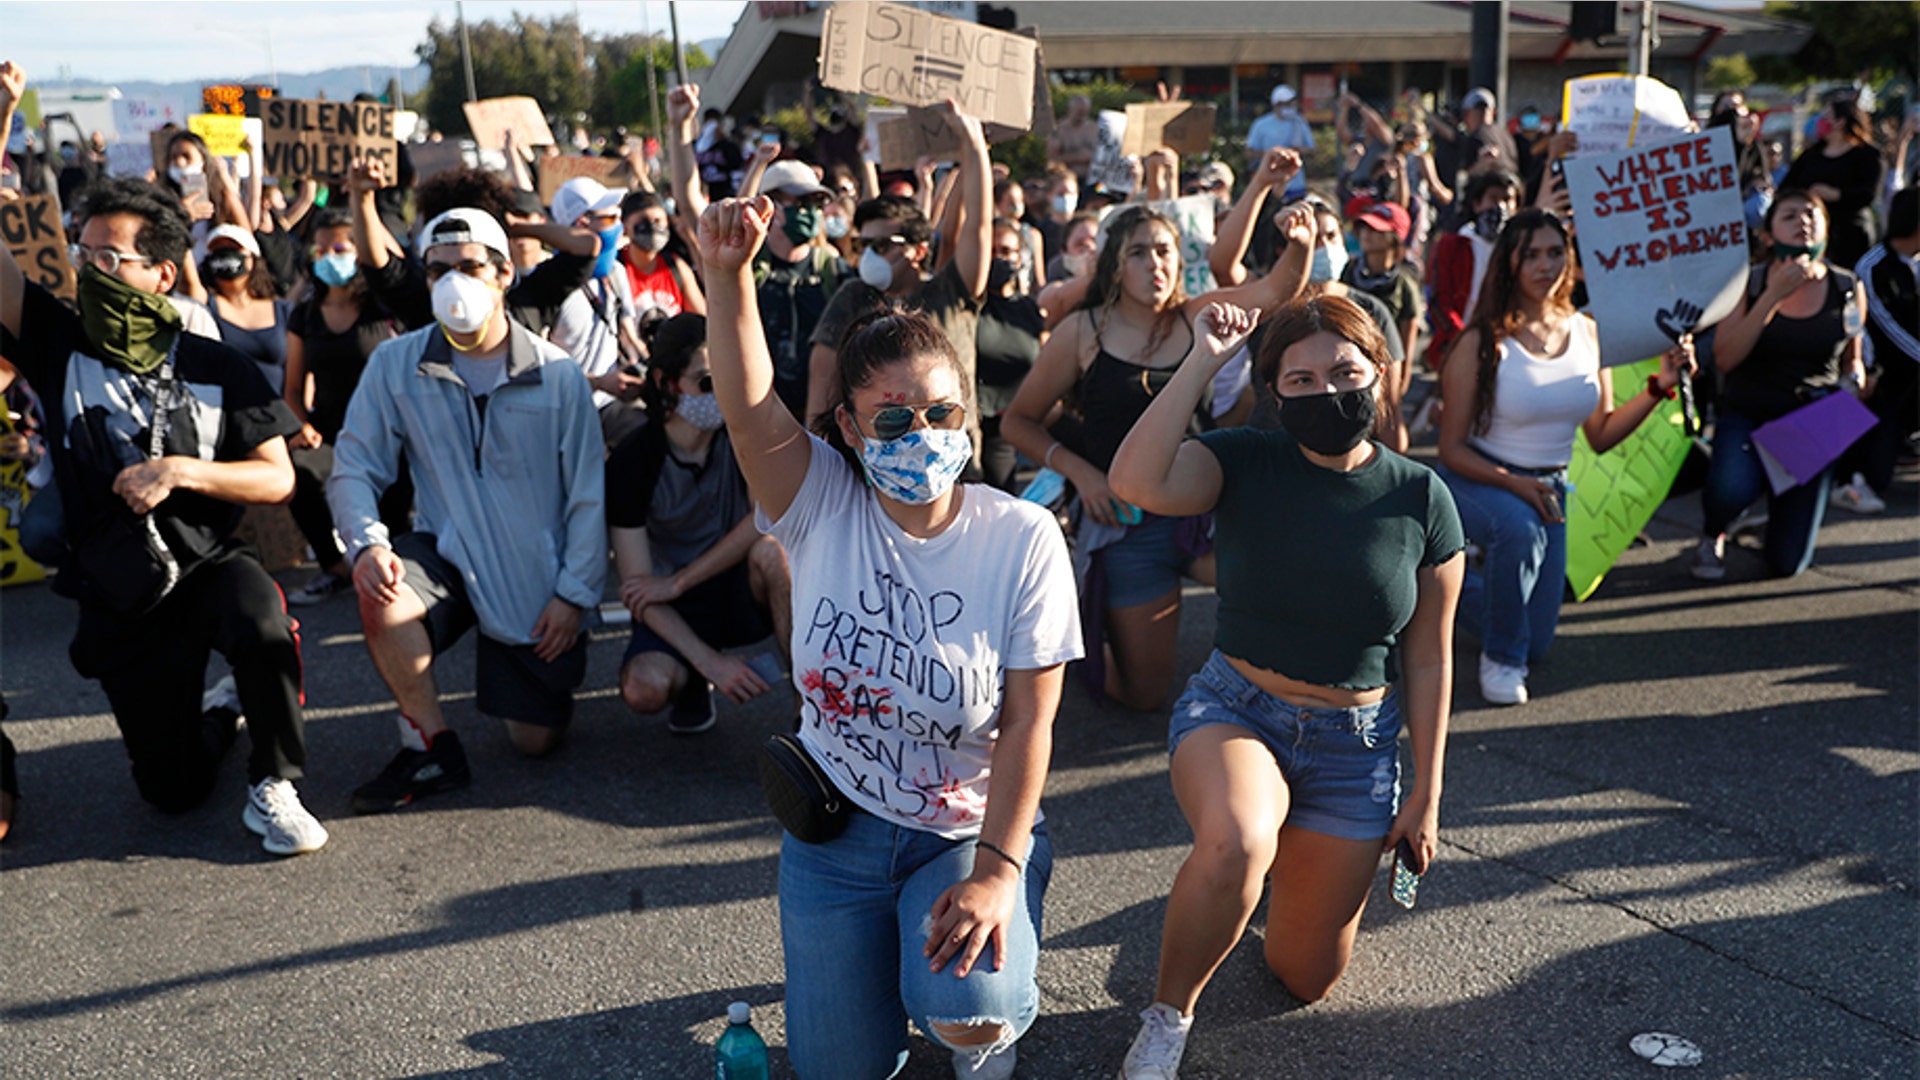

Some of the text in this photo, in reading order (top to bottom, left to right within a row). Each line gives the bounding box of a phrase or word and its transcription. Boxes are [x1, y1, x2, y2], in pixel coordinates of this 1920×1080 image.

[831, 19, 848, 76] #BLM
[866, 6, 1025, 75] SILENCE
[861, 63, 996, 110] CONSENT
[268, 101, 394, 139] SILENCE
[1596, 136, 1713, 189] WHITE
[1594, 164, 1736, 218] SILENCE
[1645, 200, 1692, 233] IS
[1594, 220, 1745, 272] VIOLENCE
[859, 568, 965, 646] STOP
[821, 666, 963, 751] RACISM
